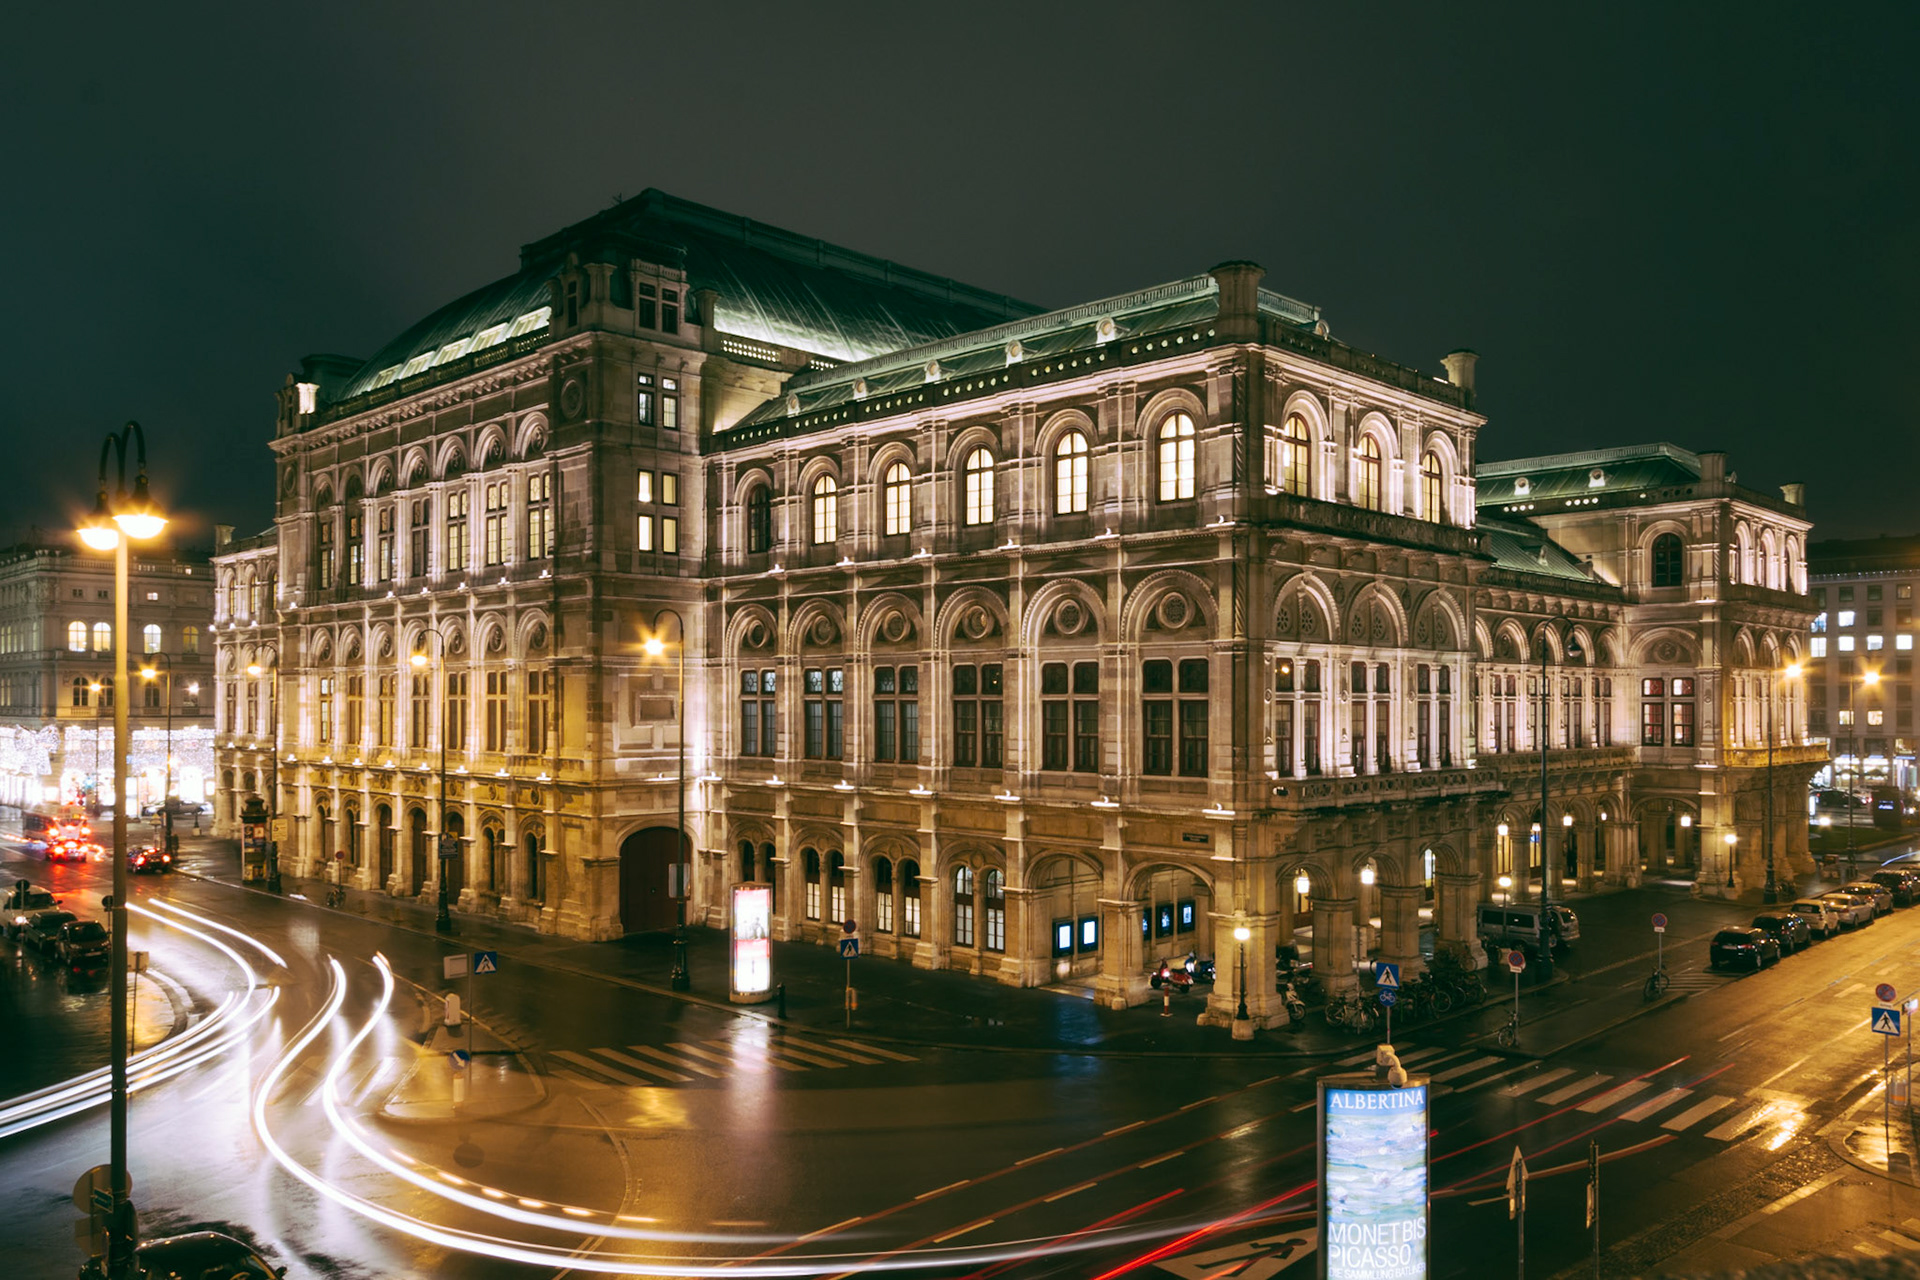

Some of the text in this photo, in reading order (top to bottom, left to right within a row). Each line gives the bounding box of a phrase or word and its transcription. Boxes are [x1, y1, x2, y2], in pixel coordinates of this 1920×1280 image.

[1330, 1090, 1424, 1109] ALBERTINA
[1329, 1217, 1426, 1245] MONET BIS
[1329, 1244, 1411, 1268] PICASSO
